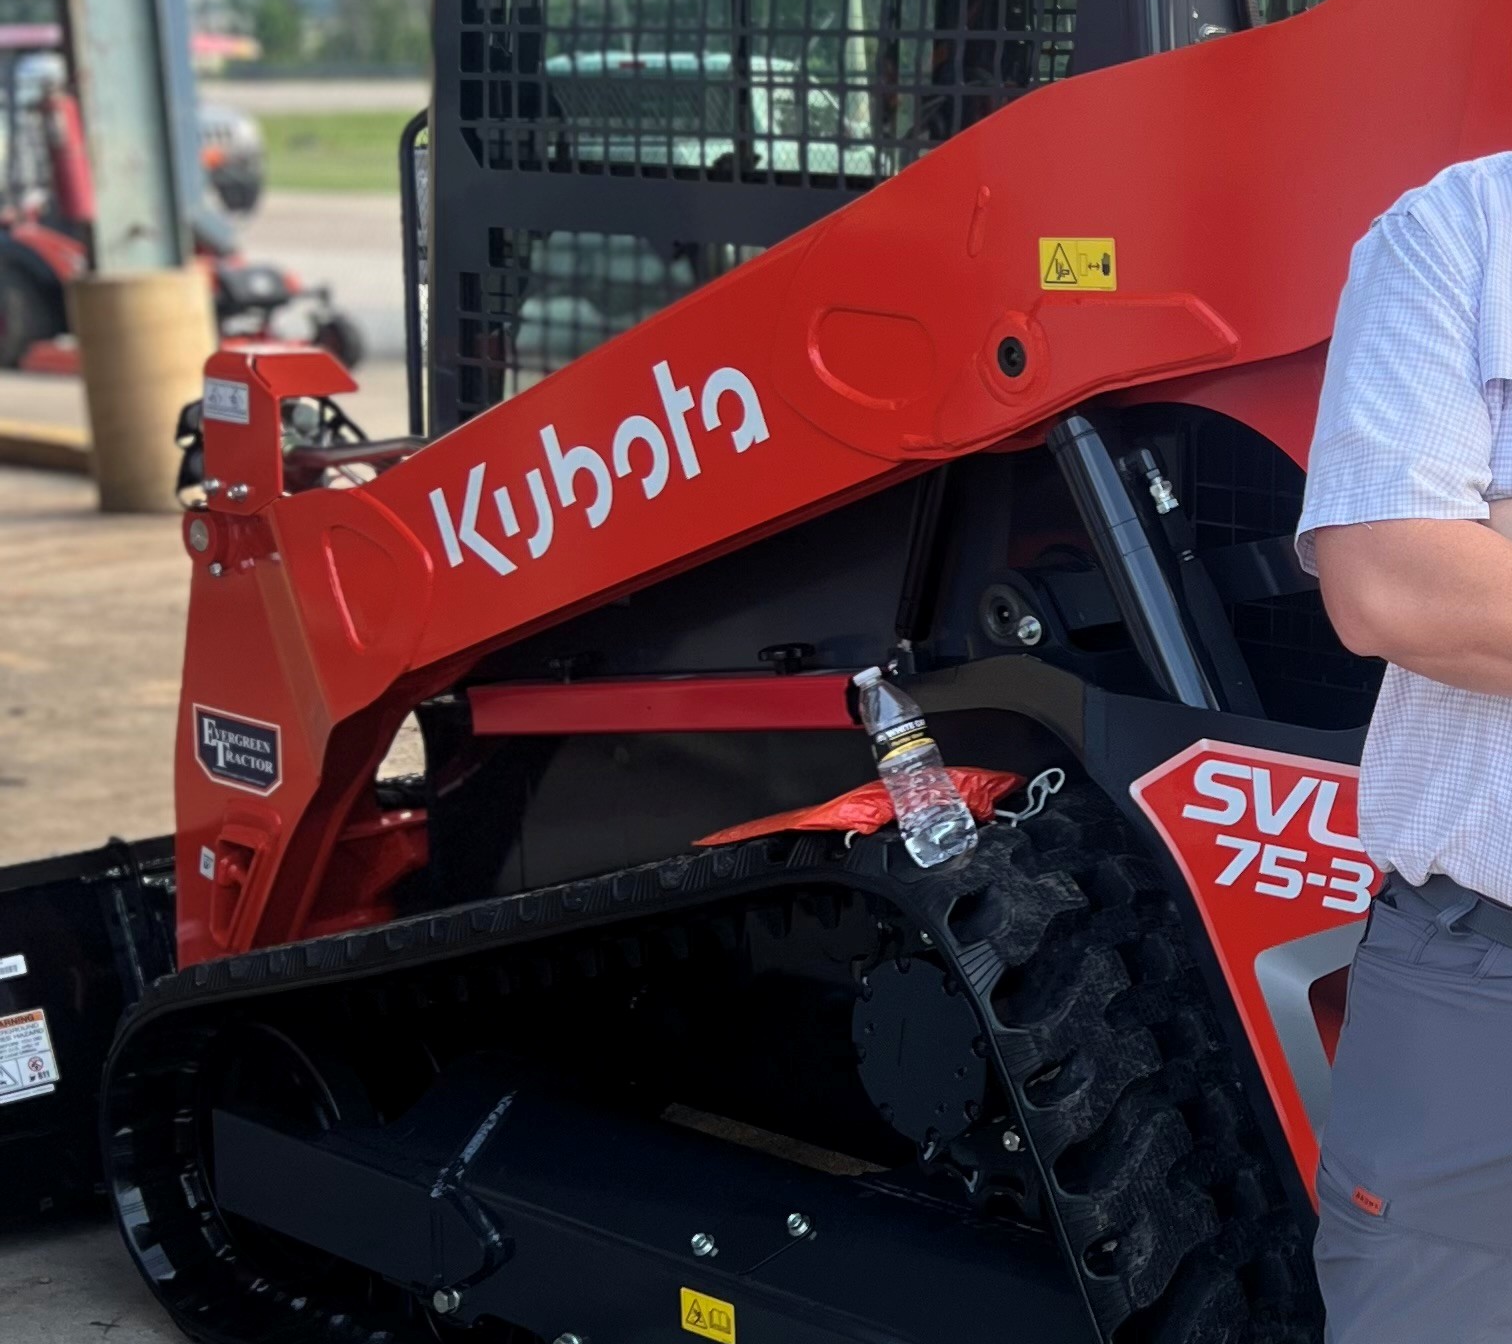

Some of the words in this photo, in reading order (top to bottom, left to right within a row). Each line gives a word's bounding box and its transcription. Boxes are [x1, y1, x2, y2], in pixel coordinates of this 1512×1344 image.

[428, 360, 770, 577] Kubota
[202, 717, 271, 754] EVERGREEN
[212, 739, 274, 774] TRACTOR
[1182, 759, 1366, 853] SVL
[1214, 834, 1375, 914] 75-3
